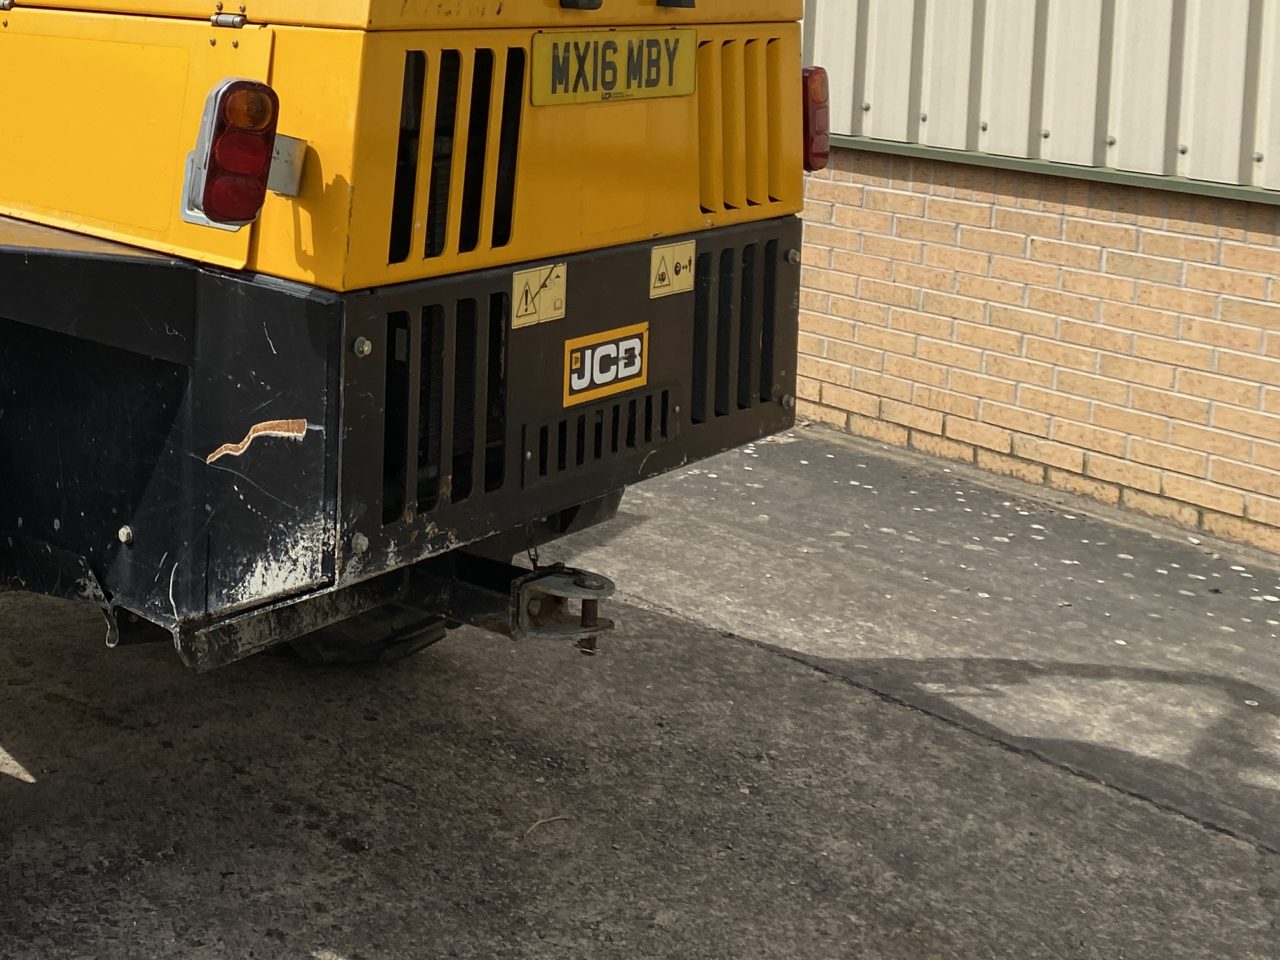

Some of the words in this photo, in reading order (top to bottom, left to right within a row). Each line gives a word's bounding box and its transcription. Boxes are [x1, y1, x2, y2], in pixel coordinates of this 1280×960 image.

[551, 40, 617, 94] MX16
[626, 38, 680, 90] MBY
[570, 338, 642, 390] JCB
